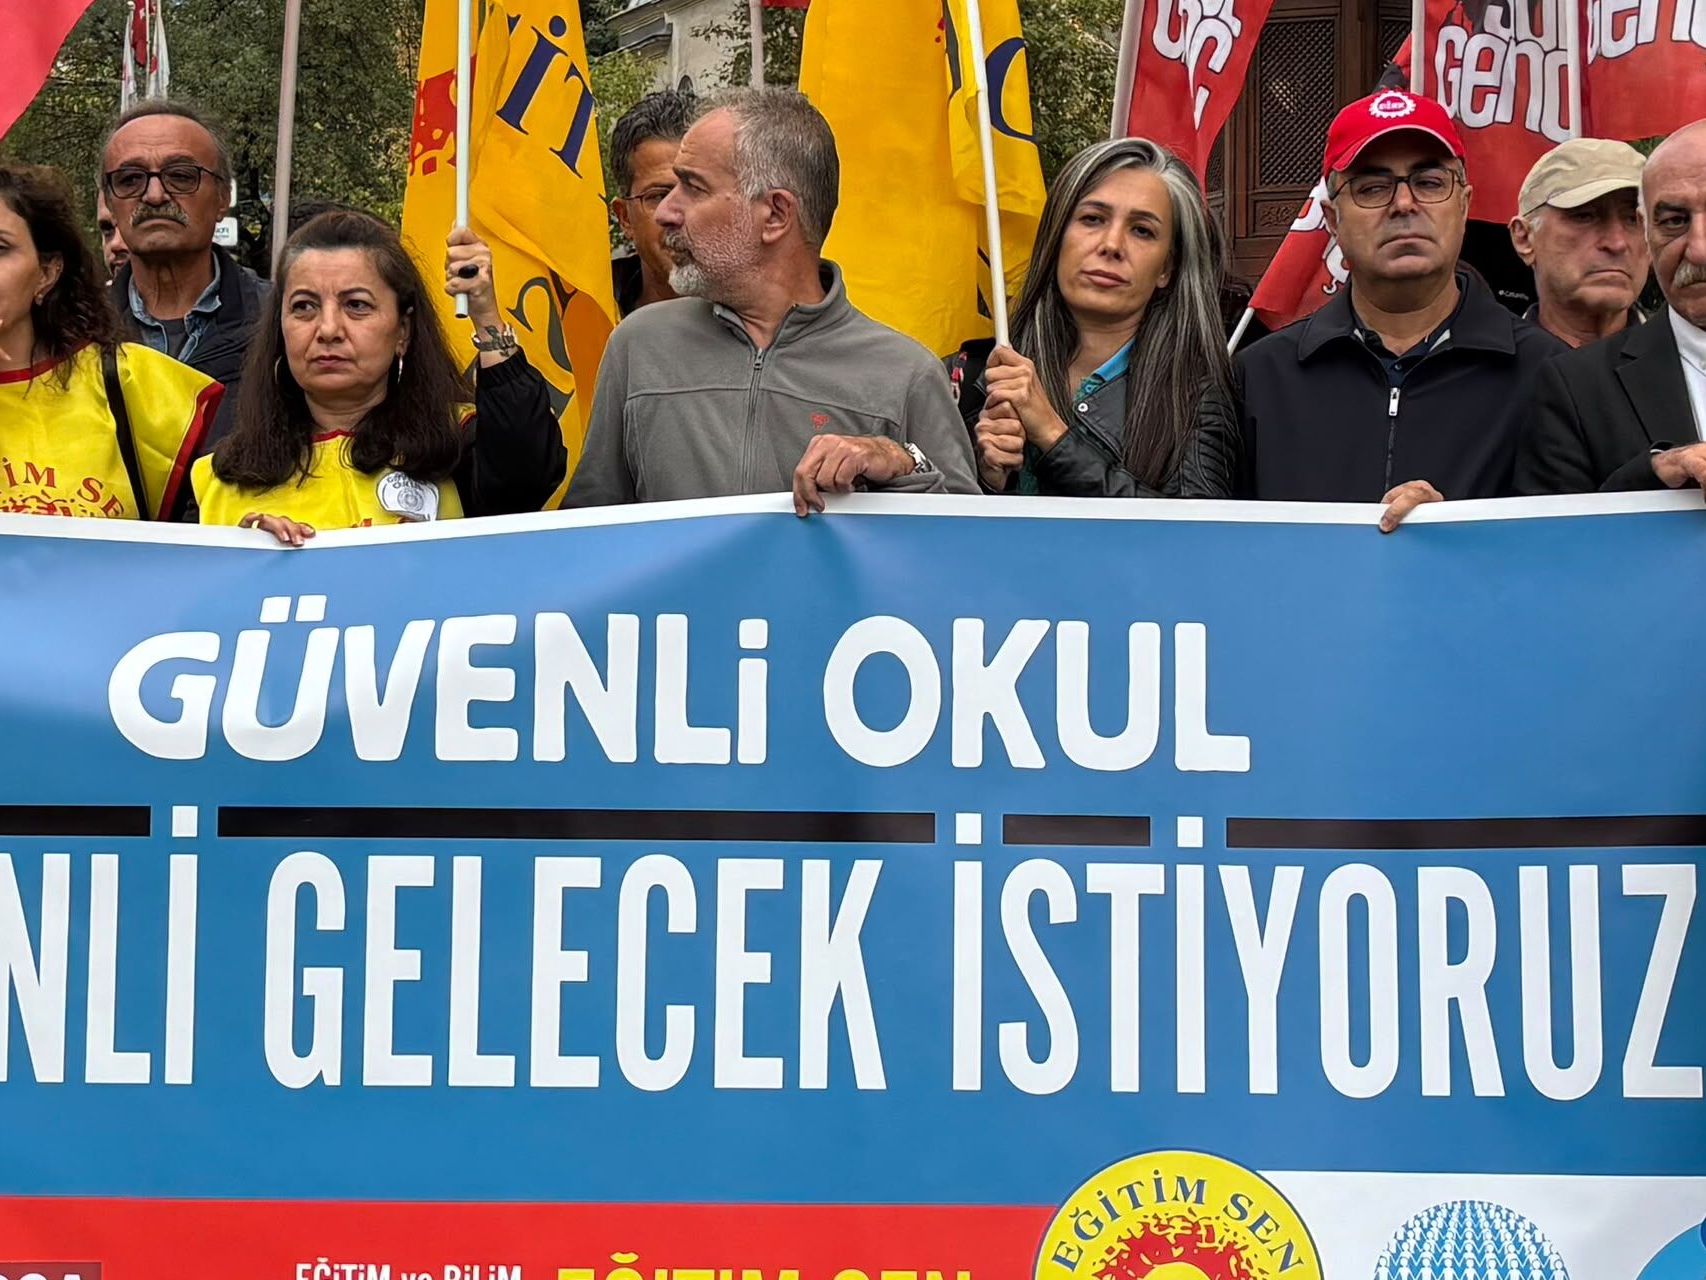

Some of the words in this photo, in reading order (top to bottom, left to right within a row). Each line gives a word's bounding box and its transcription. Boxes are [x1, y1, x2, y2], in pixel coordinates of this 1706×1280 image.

[77, 477, 124, 517] SE
[822, 615, 1251, 773] OKUL
[263, 852, 887, 1091] GELECEK
[1051, 1169, 1207, 1272] EĞİTİM
[1222, 1193, 1305, 1273] SEN
